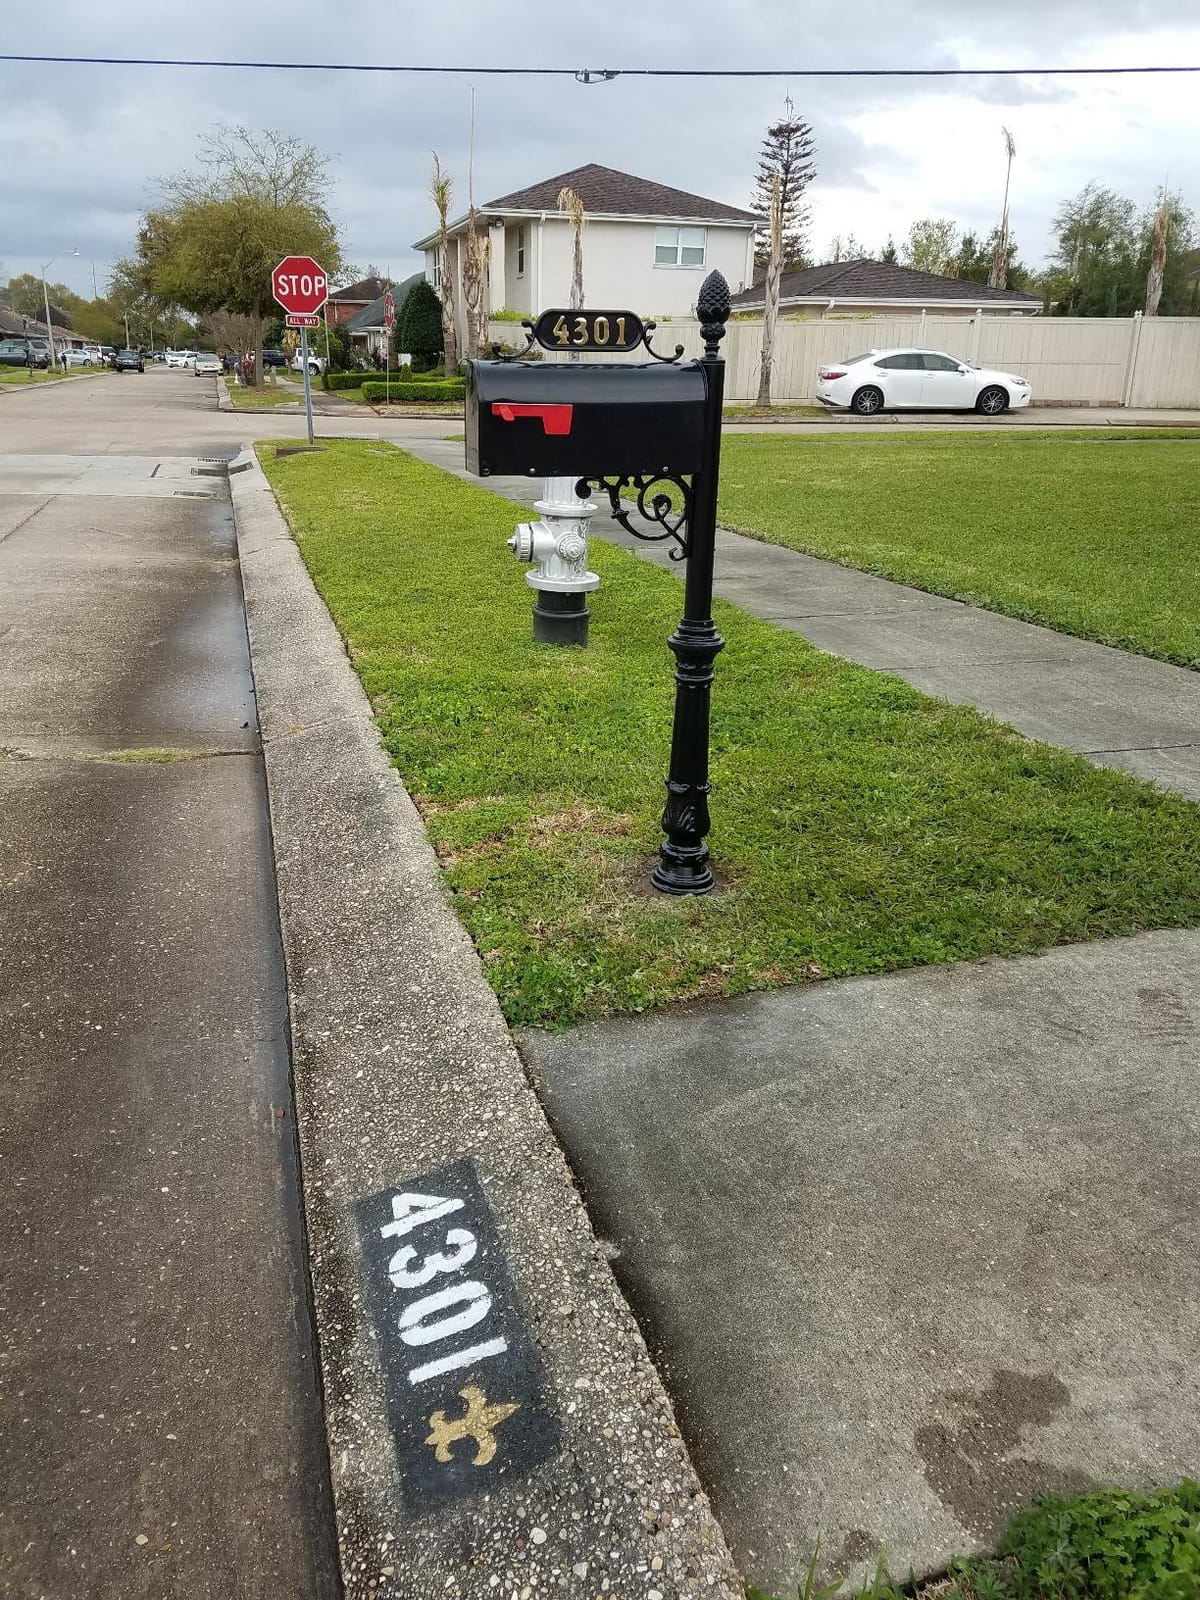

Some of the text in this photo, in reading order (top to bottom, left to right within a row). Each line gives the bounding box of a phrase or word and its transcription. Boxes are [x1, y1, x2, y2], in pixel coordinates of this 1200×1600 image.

[278, 274, 325, 297] STOP
[289, 317, 317, 326] ALL WAY
[552, 315, 626, 345] 4301
[380, 1193, 508, 1386] 4301
